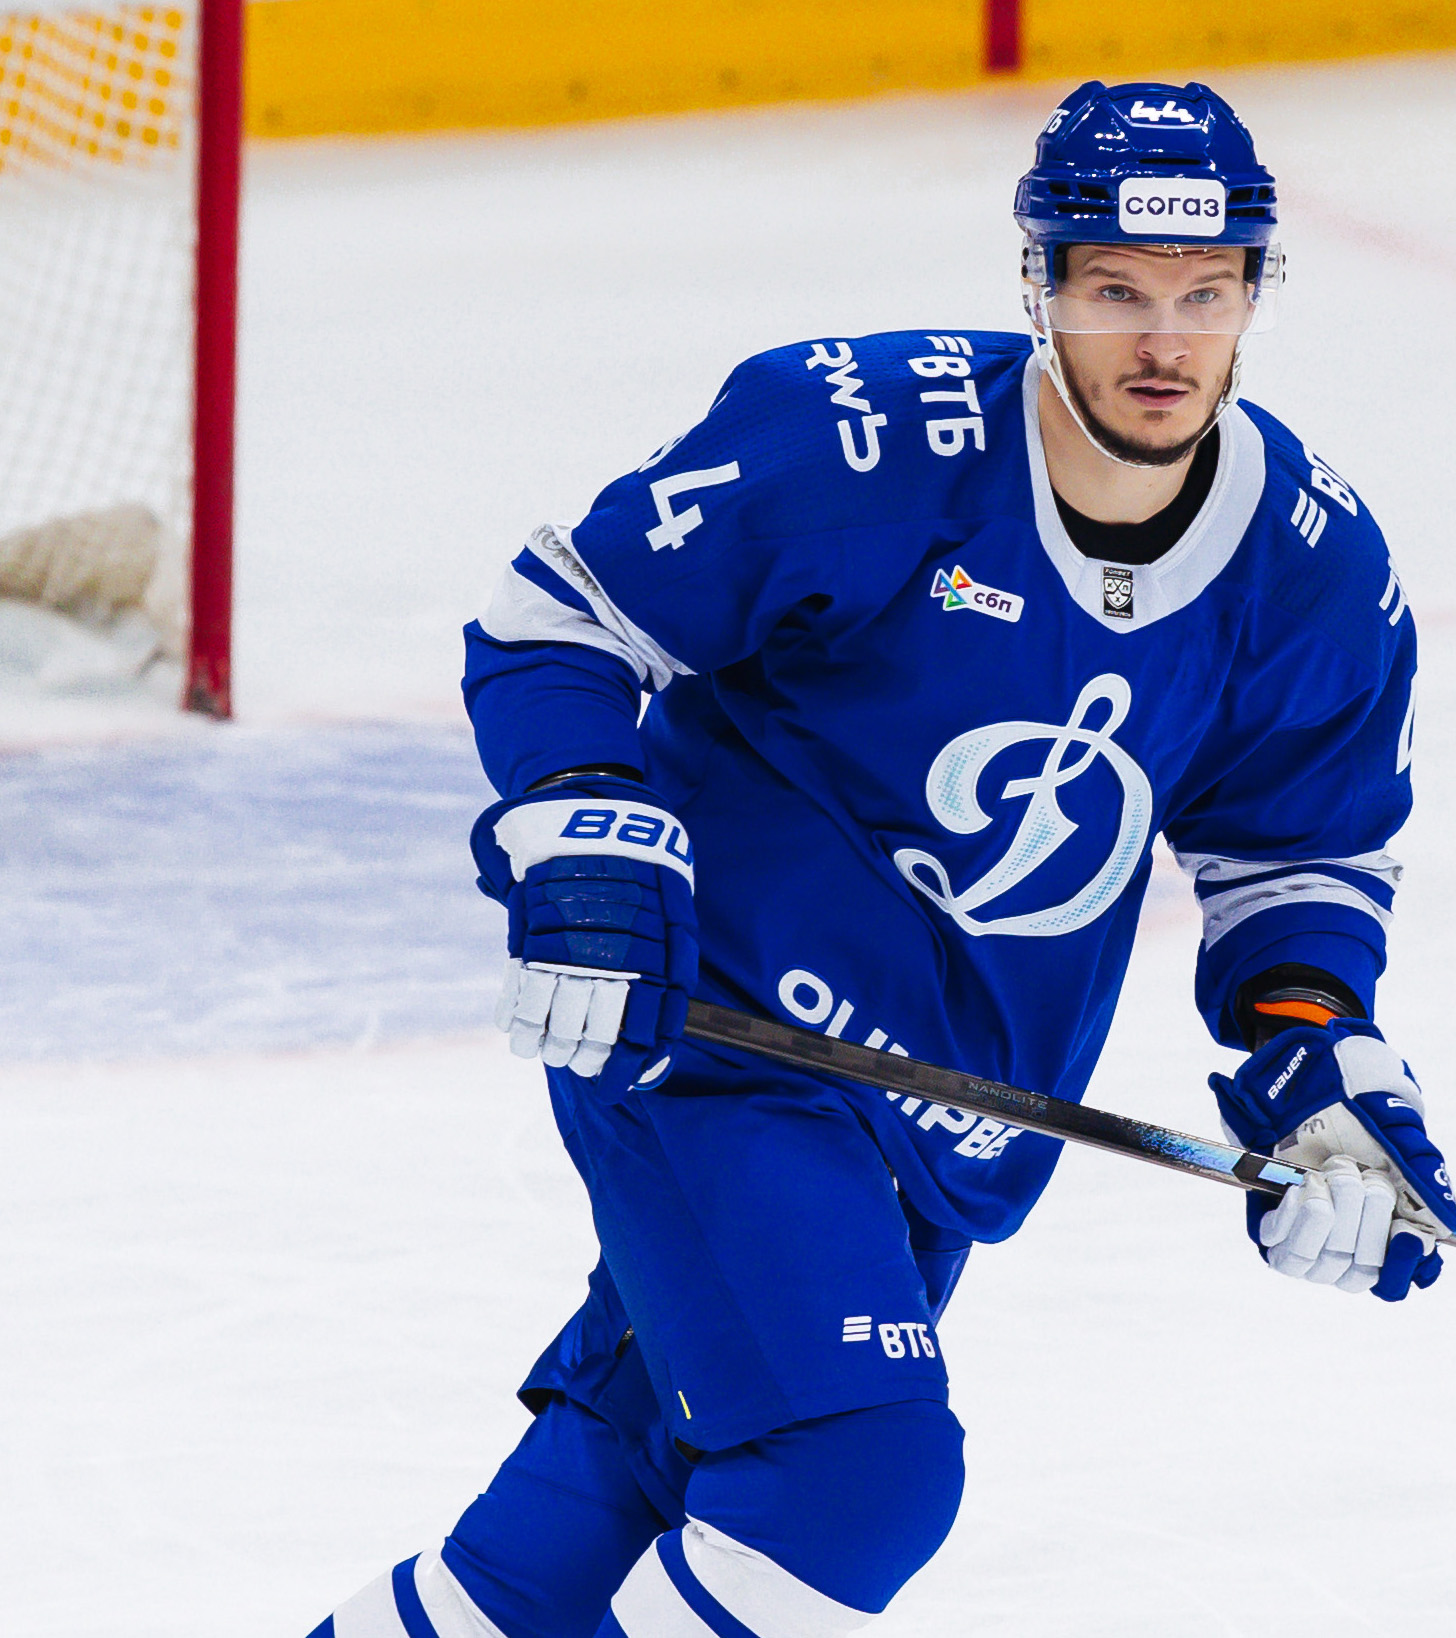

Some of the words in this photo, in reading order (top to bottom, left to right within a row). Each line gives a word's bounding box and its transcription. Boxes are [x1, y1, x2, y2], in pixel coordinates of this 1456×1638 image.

[1131, 100, 1195, 122] 44
[973, 589, 1012, 613] сбп
[968, 1082, 1048, 1110] NANOLITE
